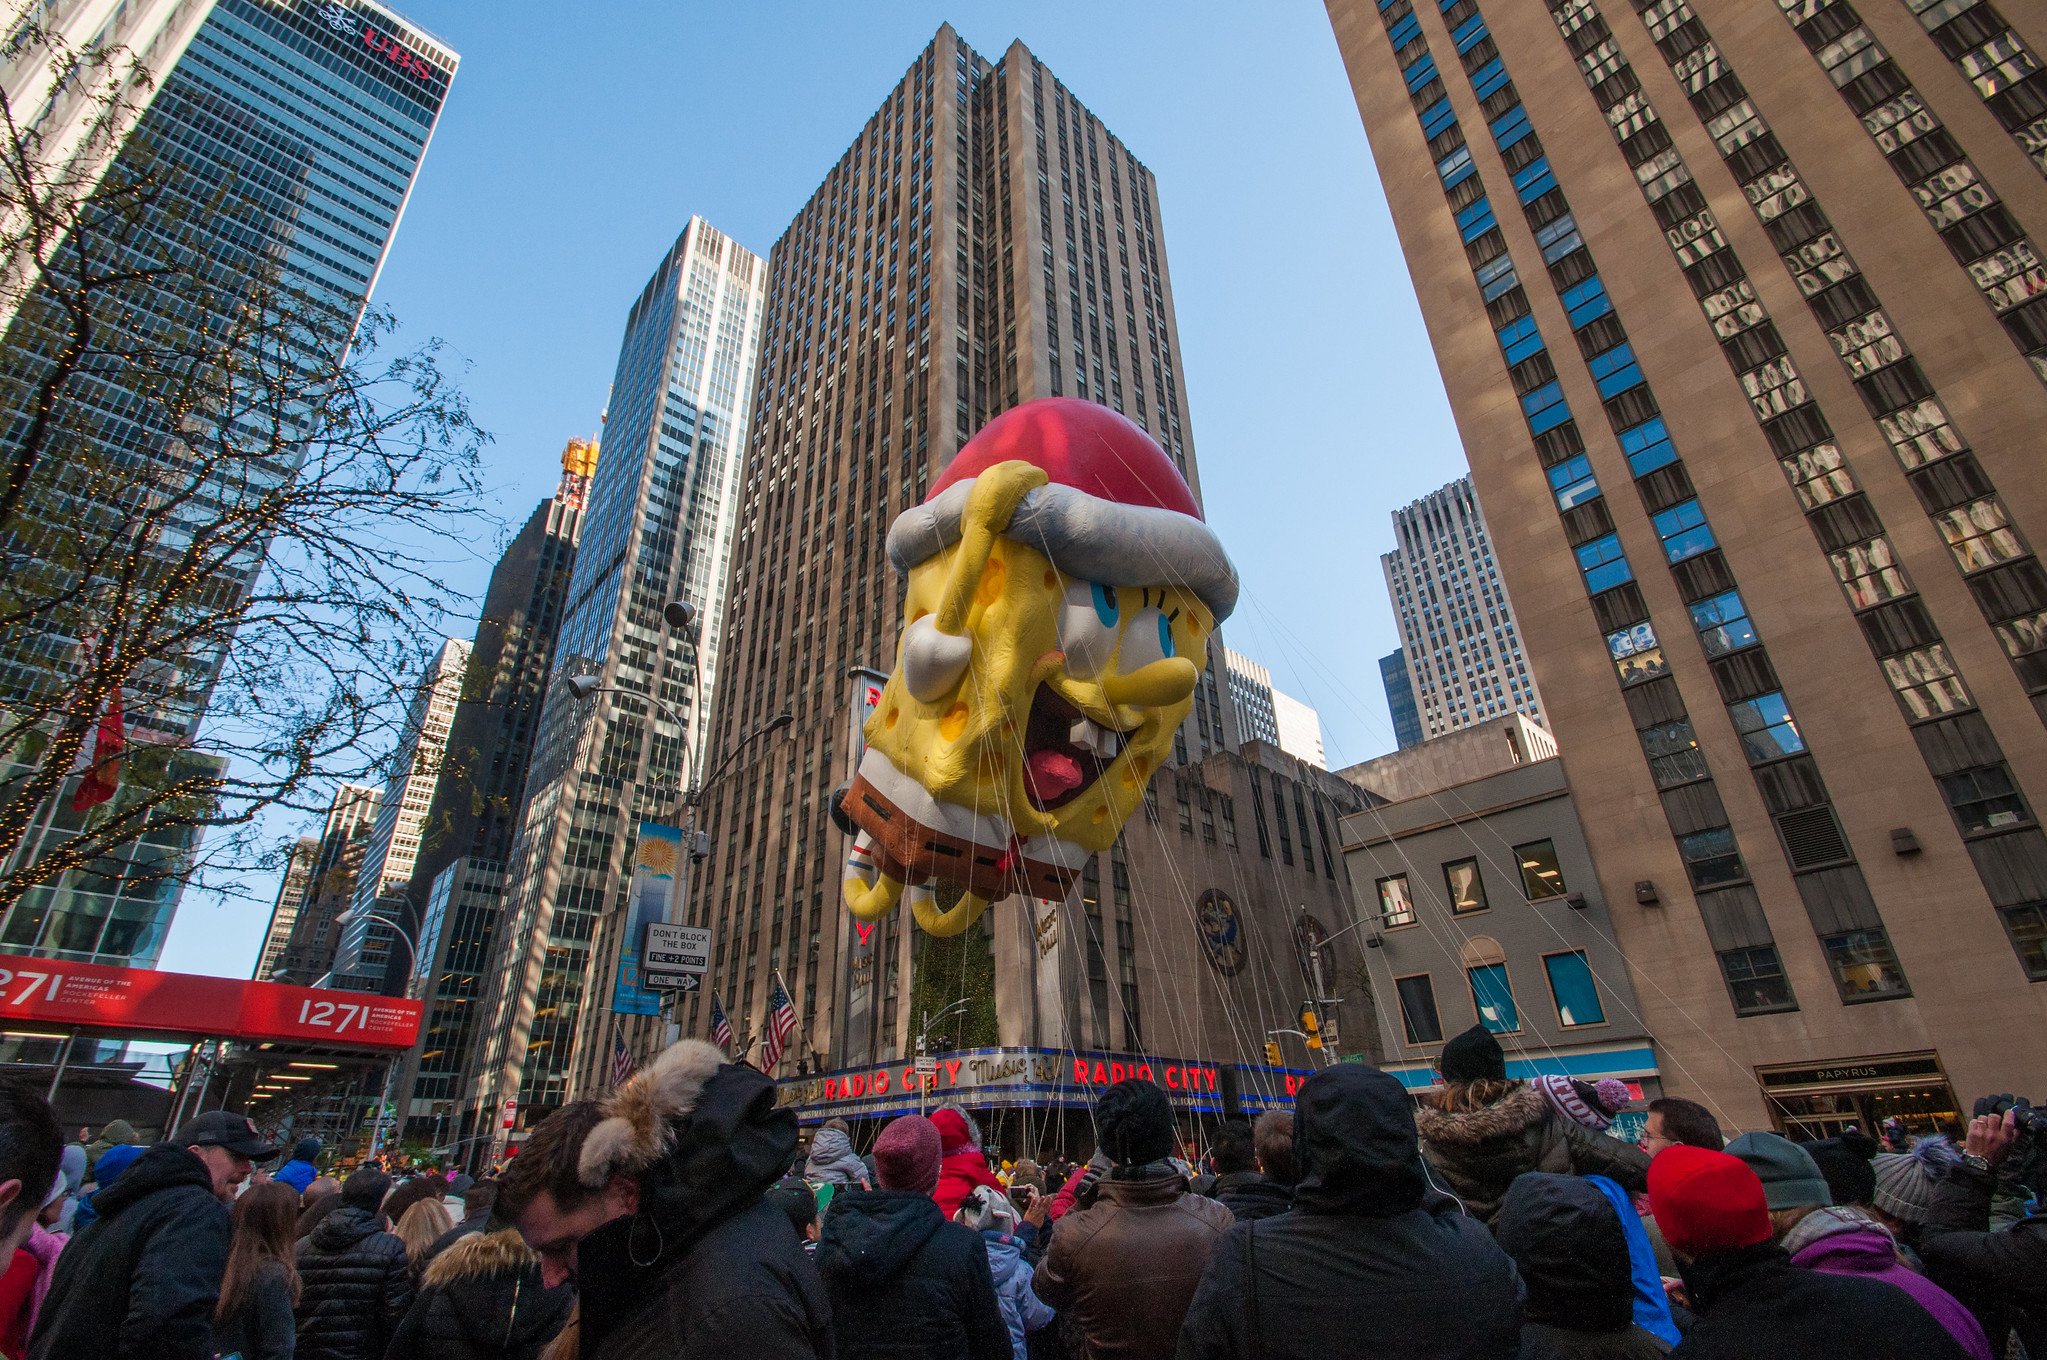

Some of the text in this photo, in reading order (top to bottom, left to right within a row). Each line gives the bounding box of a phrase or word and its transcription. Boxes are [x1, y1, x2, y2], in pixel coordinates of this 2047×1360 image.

[364, 27, 431, 80] UBS
[653, 929, 707, 942] DON'T BLOCK
[662, 939, 697, 950] THE BOX
[651, 954, 704, 966] FINE +2 POINTS
[68, 976, 101, 984] AVENUE
[622, 967, 645, 986] 12
[653, 975, 693, 987] ONE WAY
[65, 983, 109, 992] AMERICAS
[60, 997, 96, 1005] CENTER
[63, 990, 127, 1000] ROCKEFELLER
[298, 999, 369, 1033] 1271
[369, 1019, 414, 1027] ROCKEFELLER
[825, 1071, 889, 1100] RADIO
[1074, 1059, 1152, 1085] RADIO
[1166, 1066, 1216, 1090] CITY
[1817, 1066, 1877, 1081] PAPYRUS
